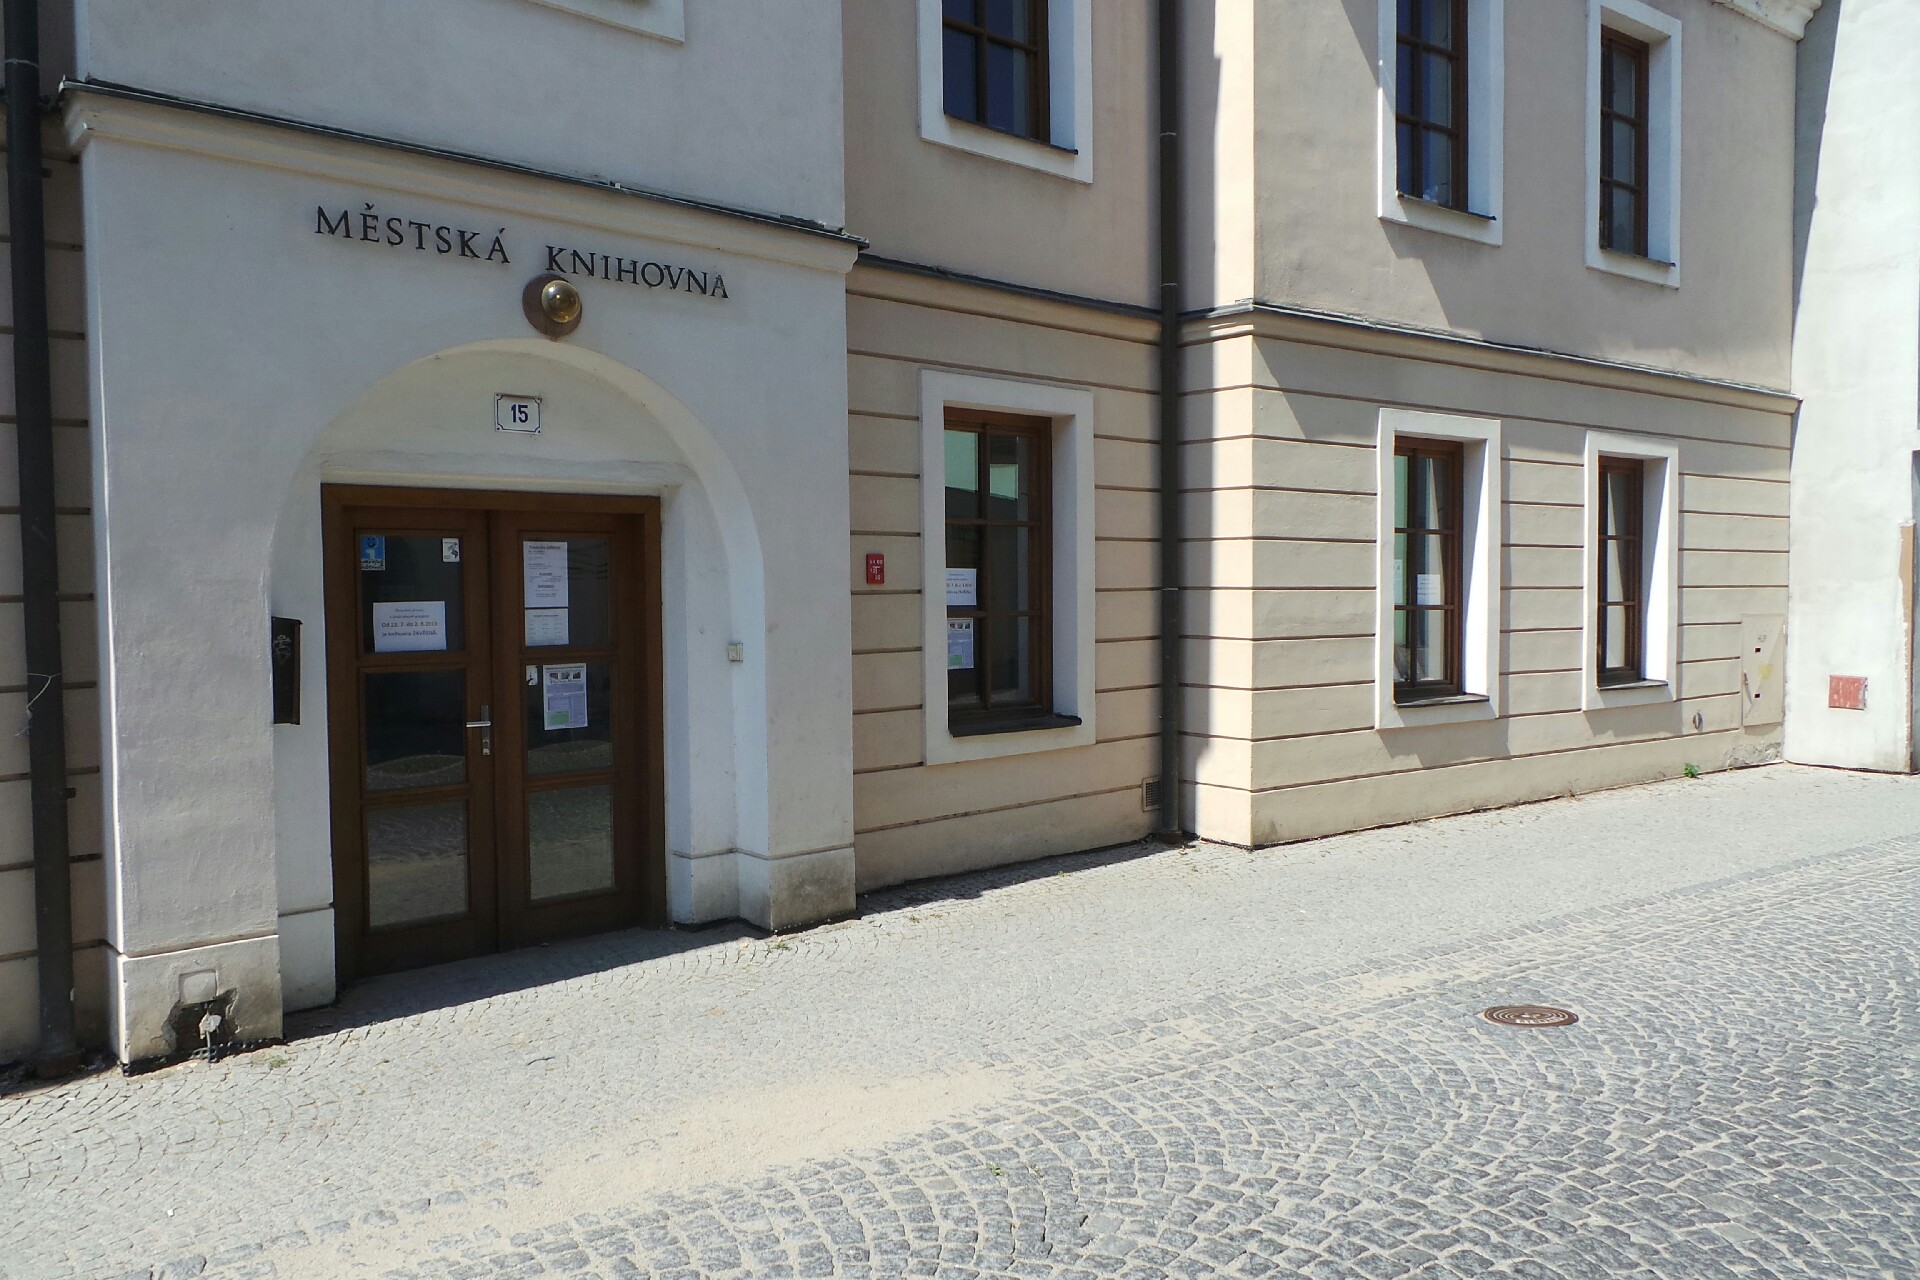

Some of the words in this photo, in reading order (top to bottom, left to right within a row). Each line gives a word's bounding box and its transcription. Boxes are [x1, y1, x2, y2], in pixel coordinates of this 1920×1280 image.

[314, 202, 511, 264] MĚSTSKÁ
[545, 245, 729, 298] KNIHOVNA
[510, 403, 529, 424] 15
